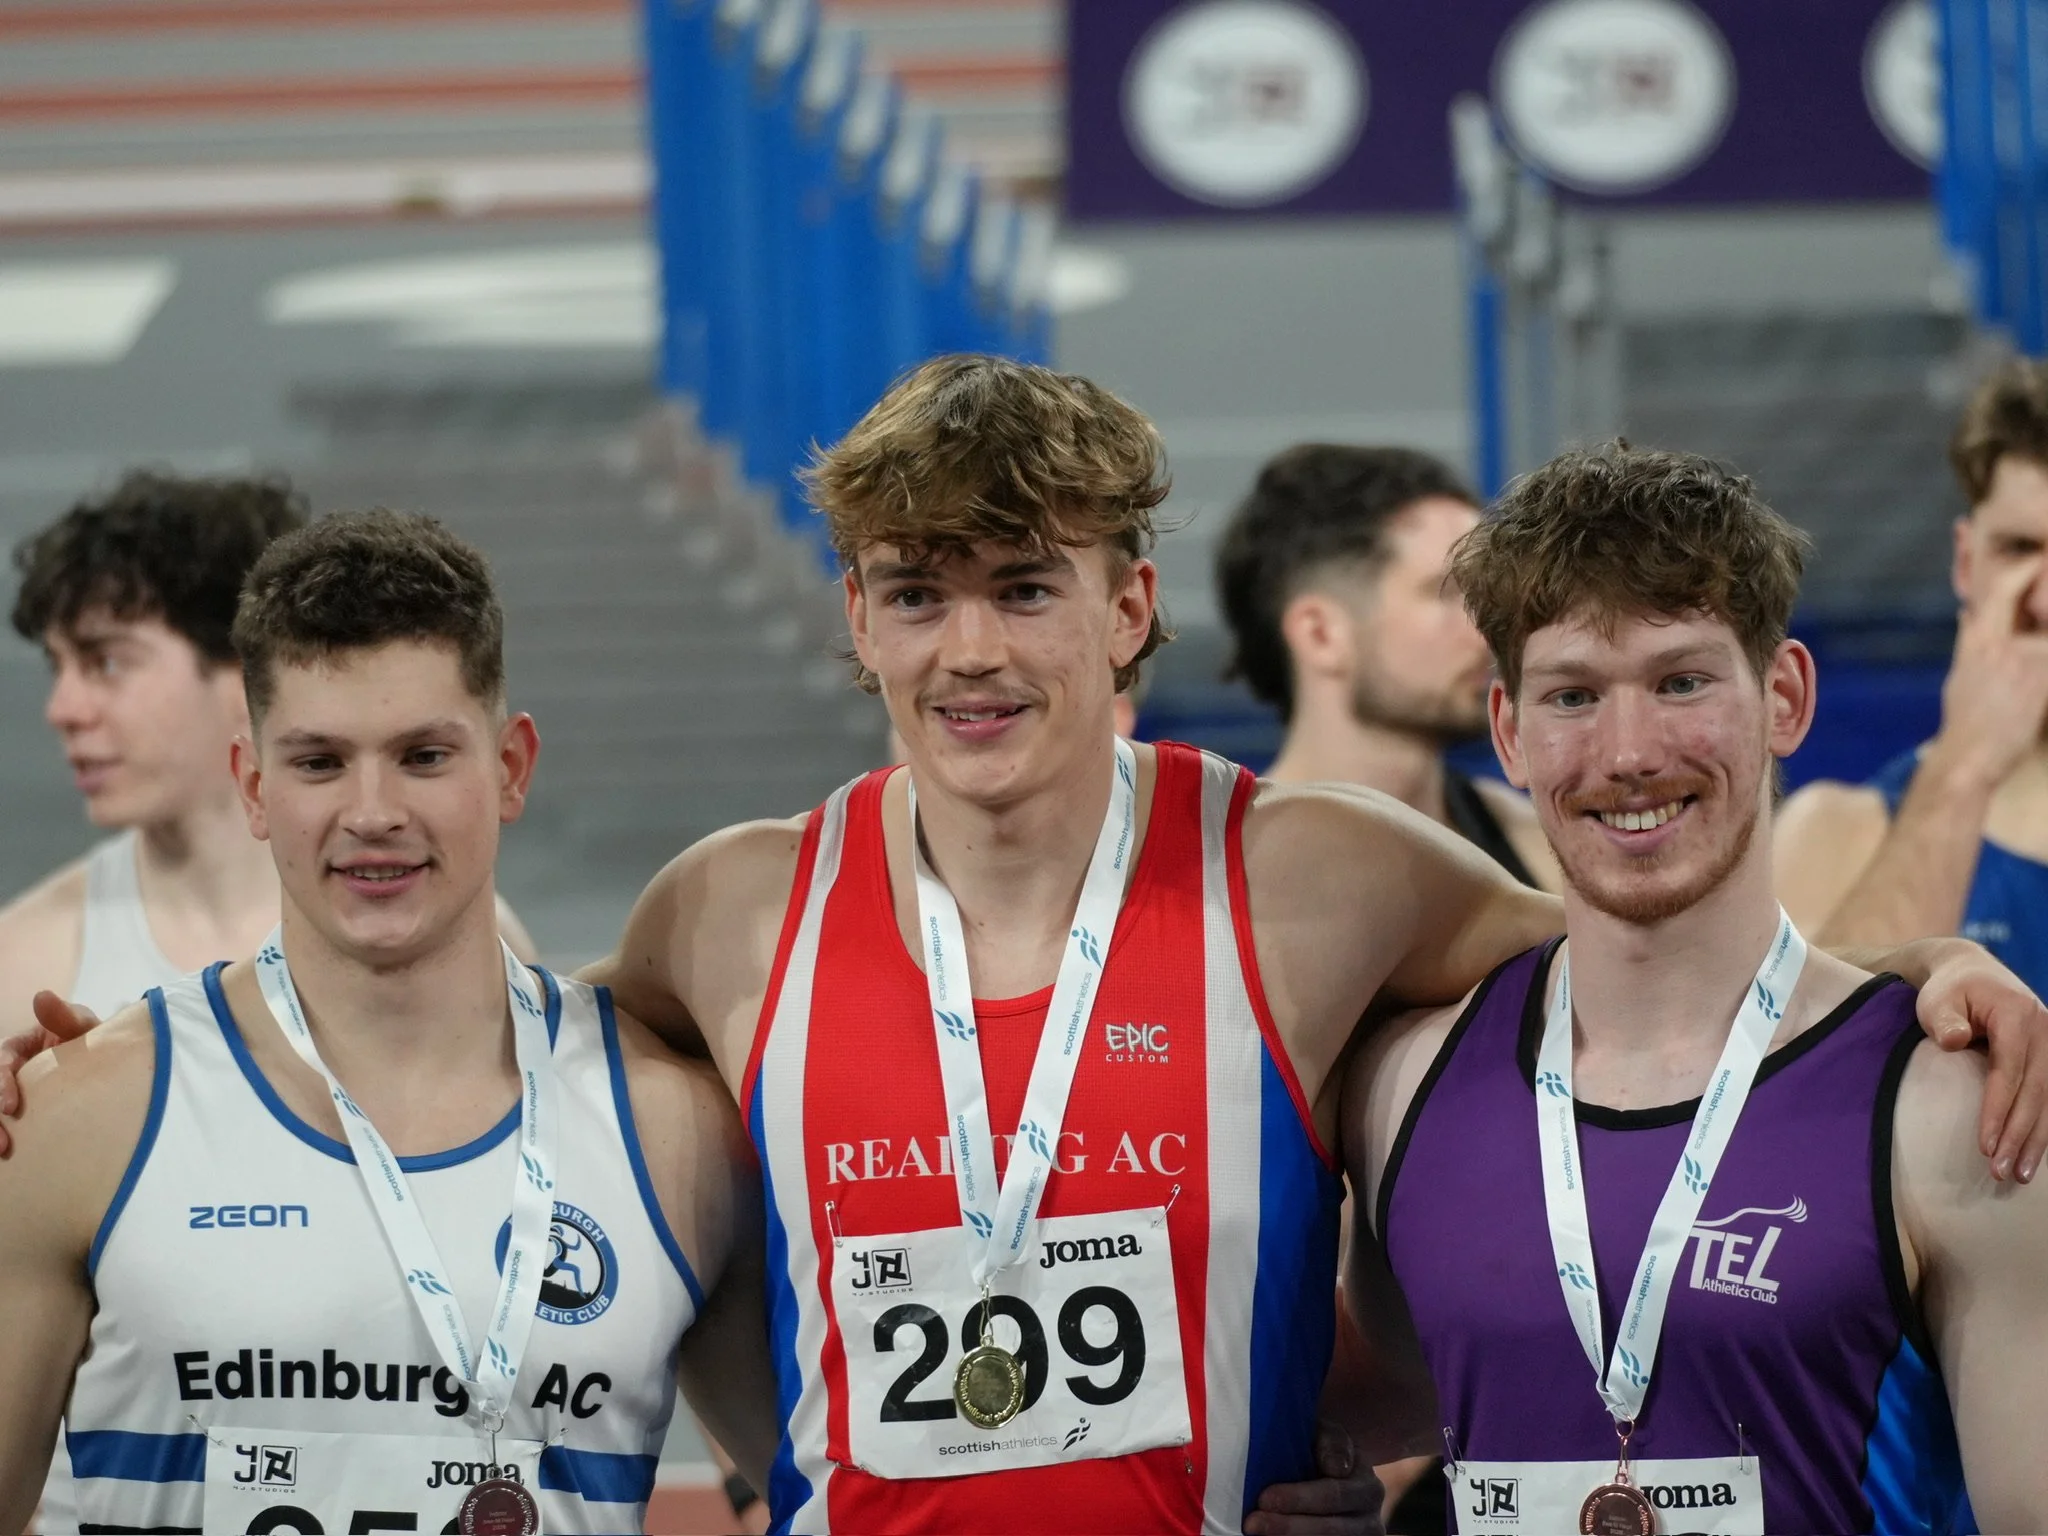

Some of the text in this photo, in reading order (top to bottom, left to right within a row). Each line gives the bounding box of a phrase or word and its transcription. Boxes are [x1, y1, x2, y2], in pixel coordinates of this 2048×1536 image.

[929, 916, 948, 1001] scottishathletics
[1063, 972, 1093, 1056] scottishathletics
[1106, 1022, 1168, 1052] EPIC
[1105, 1053, 1169, 1063] CUSTOM
[824, 1131, 1187, 1185] REAG AC
[956, 1114, 976, 1202] scottishathletics
[1010, 1166, 1042, 1250] scottishathletics
[1039, 1234, 1143, 1269] Joma
[1688, 1226, 1783, 1292] TEL
[577, 1294, 610, 1324] CLUB
[1626, 1255, 1658, 1341] scottishathletics
[1701, 1277, 1778, 1305] Athletics Club
[173, 1349, 612, 1419] Edinburg AC
[874, 1286, 1146, 1422] 299
[938, 1434, 1058, 1456] scottishathletics
